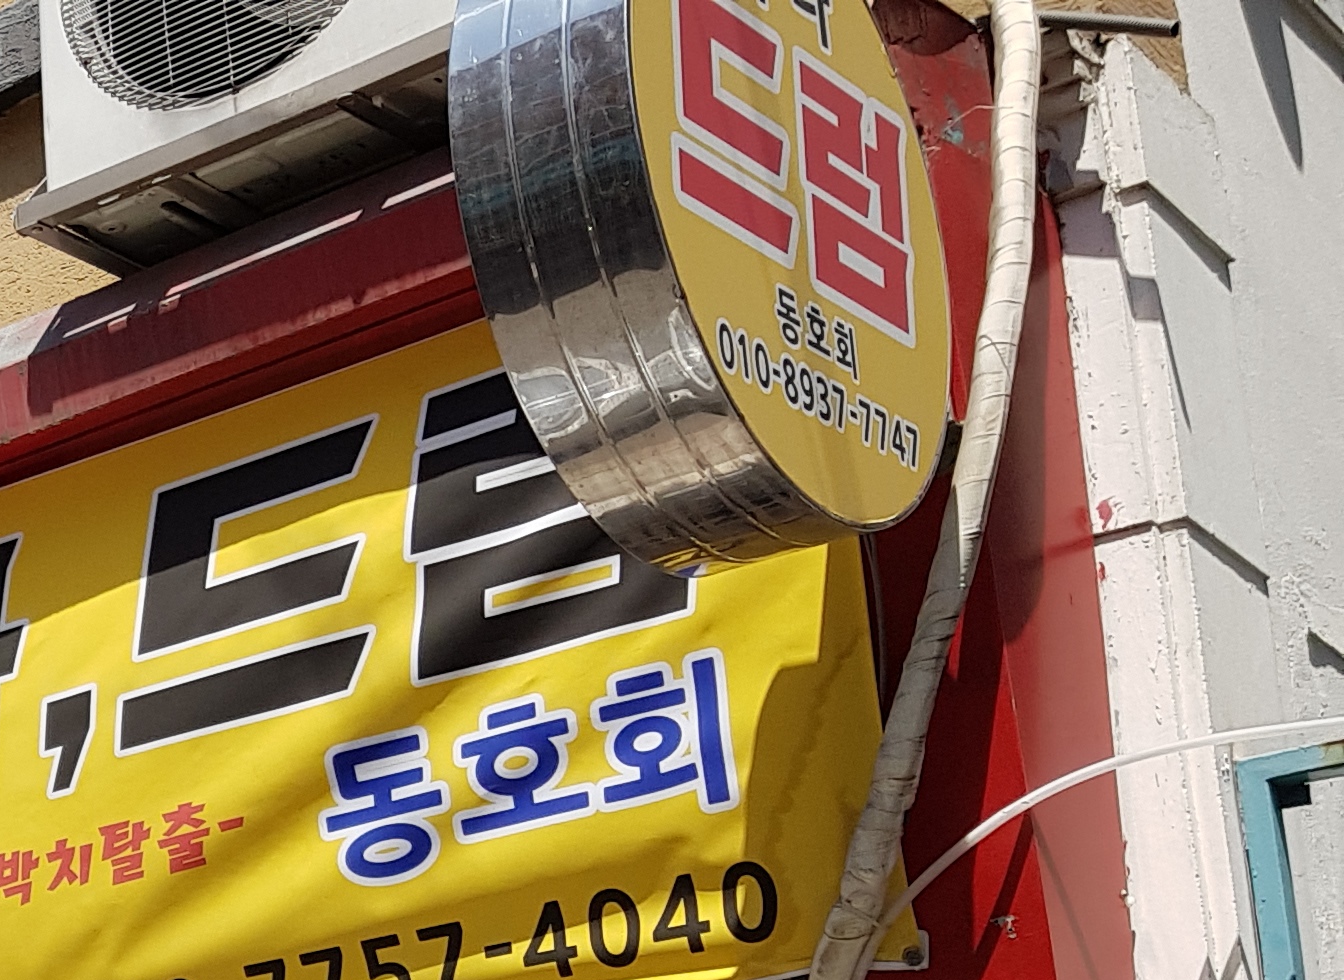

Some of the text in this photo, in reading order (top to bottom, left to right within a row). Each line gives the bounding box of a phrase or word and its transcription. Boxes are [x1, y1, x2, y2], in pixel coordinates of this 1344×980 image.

[716, 317, 920, 470] 010-8937-7747
[775, 284, 860, 382] 동호회
[319, 649, 740, 886] 동호회
